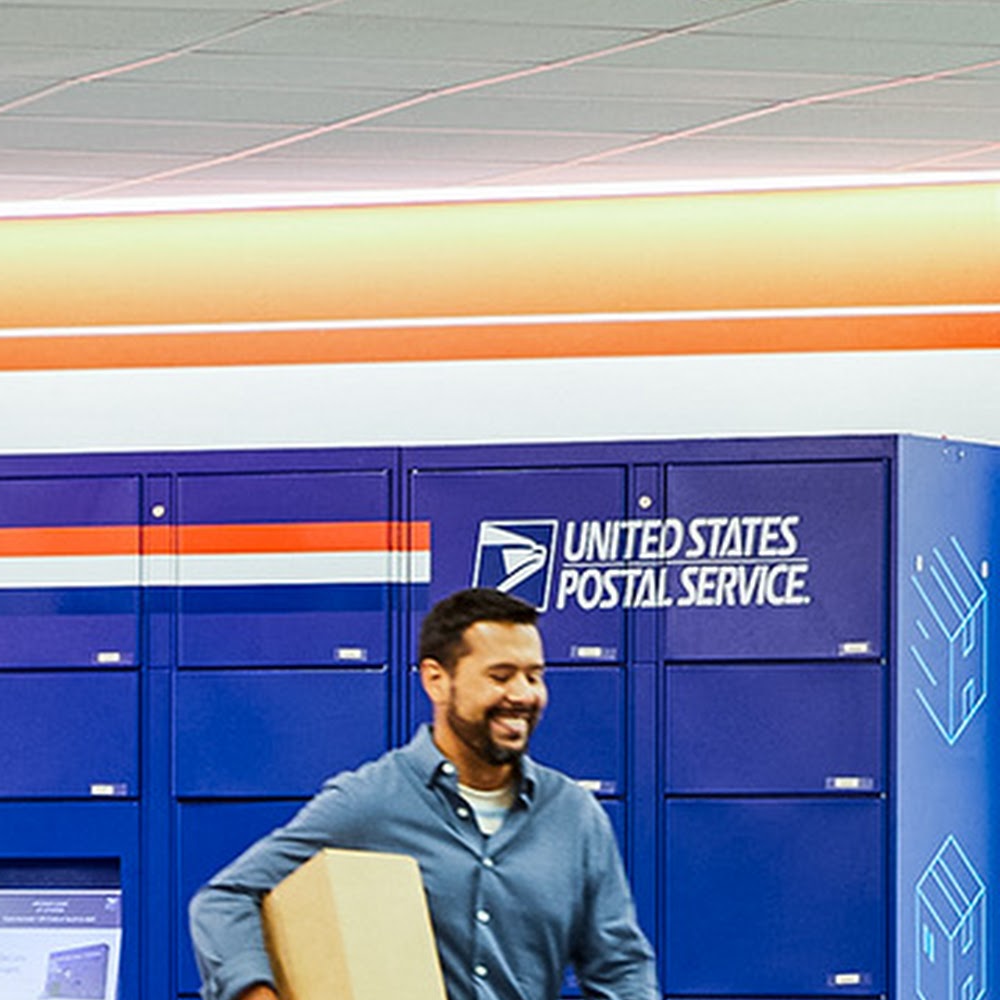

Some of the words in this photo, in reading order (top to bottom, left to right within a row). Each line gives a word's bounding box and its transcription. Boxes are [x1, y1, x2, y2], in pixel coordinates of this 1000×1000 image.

[562, 518, 684, 562] UNITED
[685, 516, 799, 558] STATES
[556, 567, 674, 610] POSTAL
